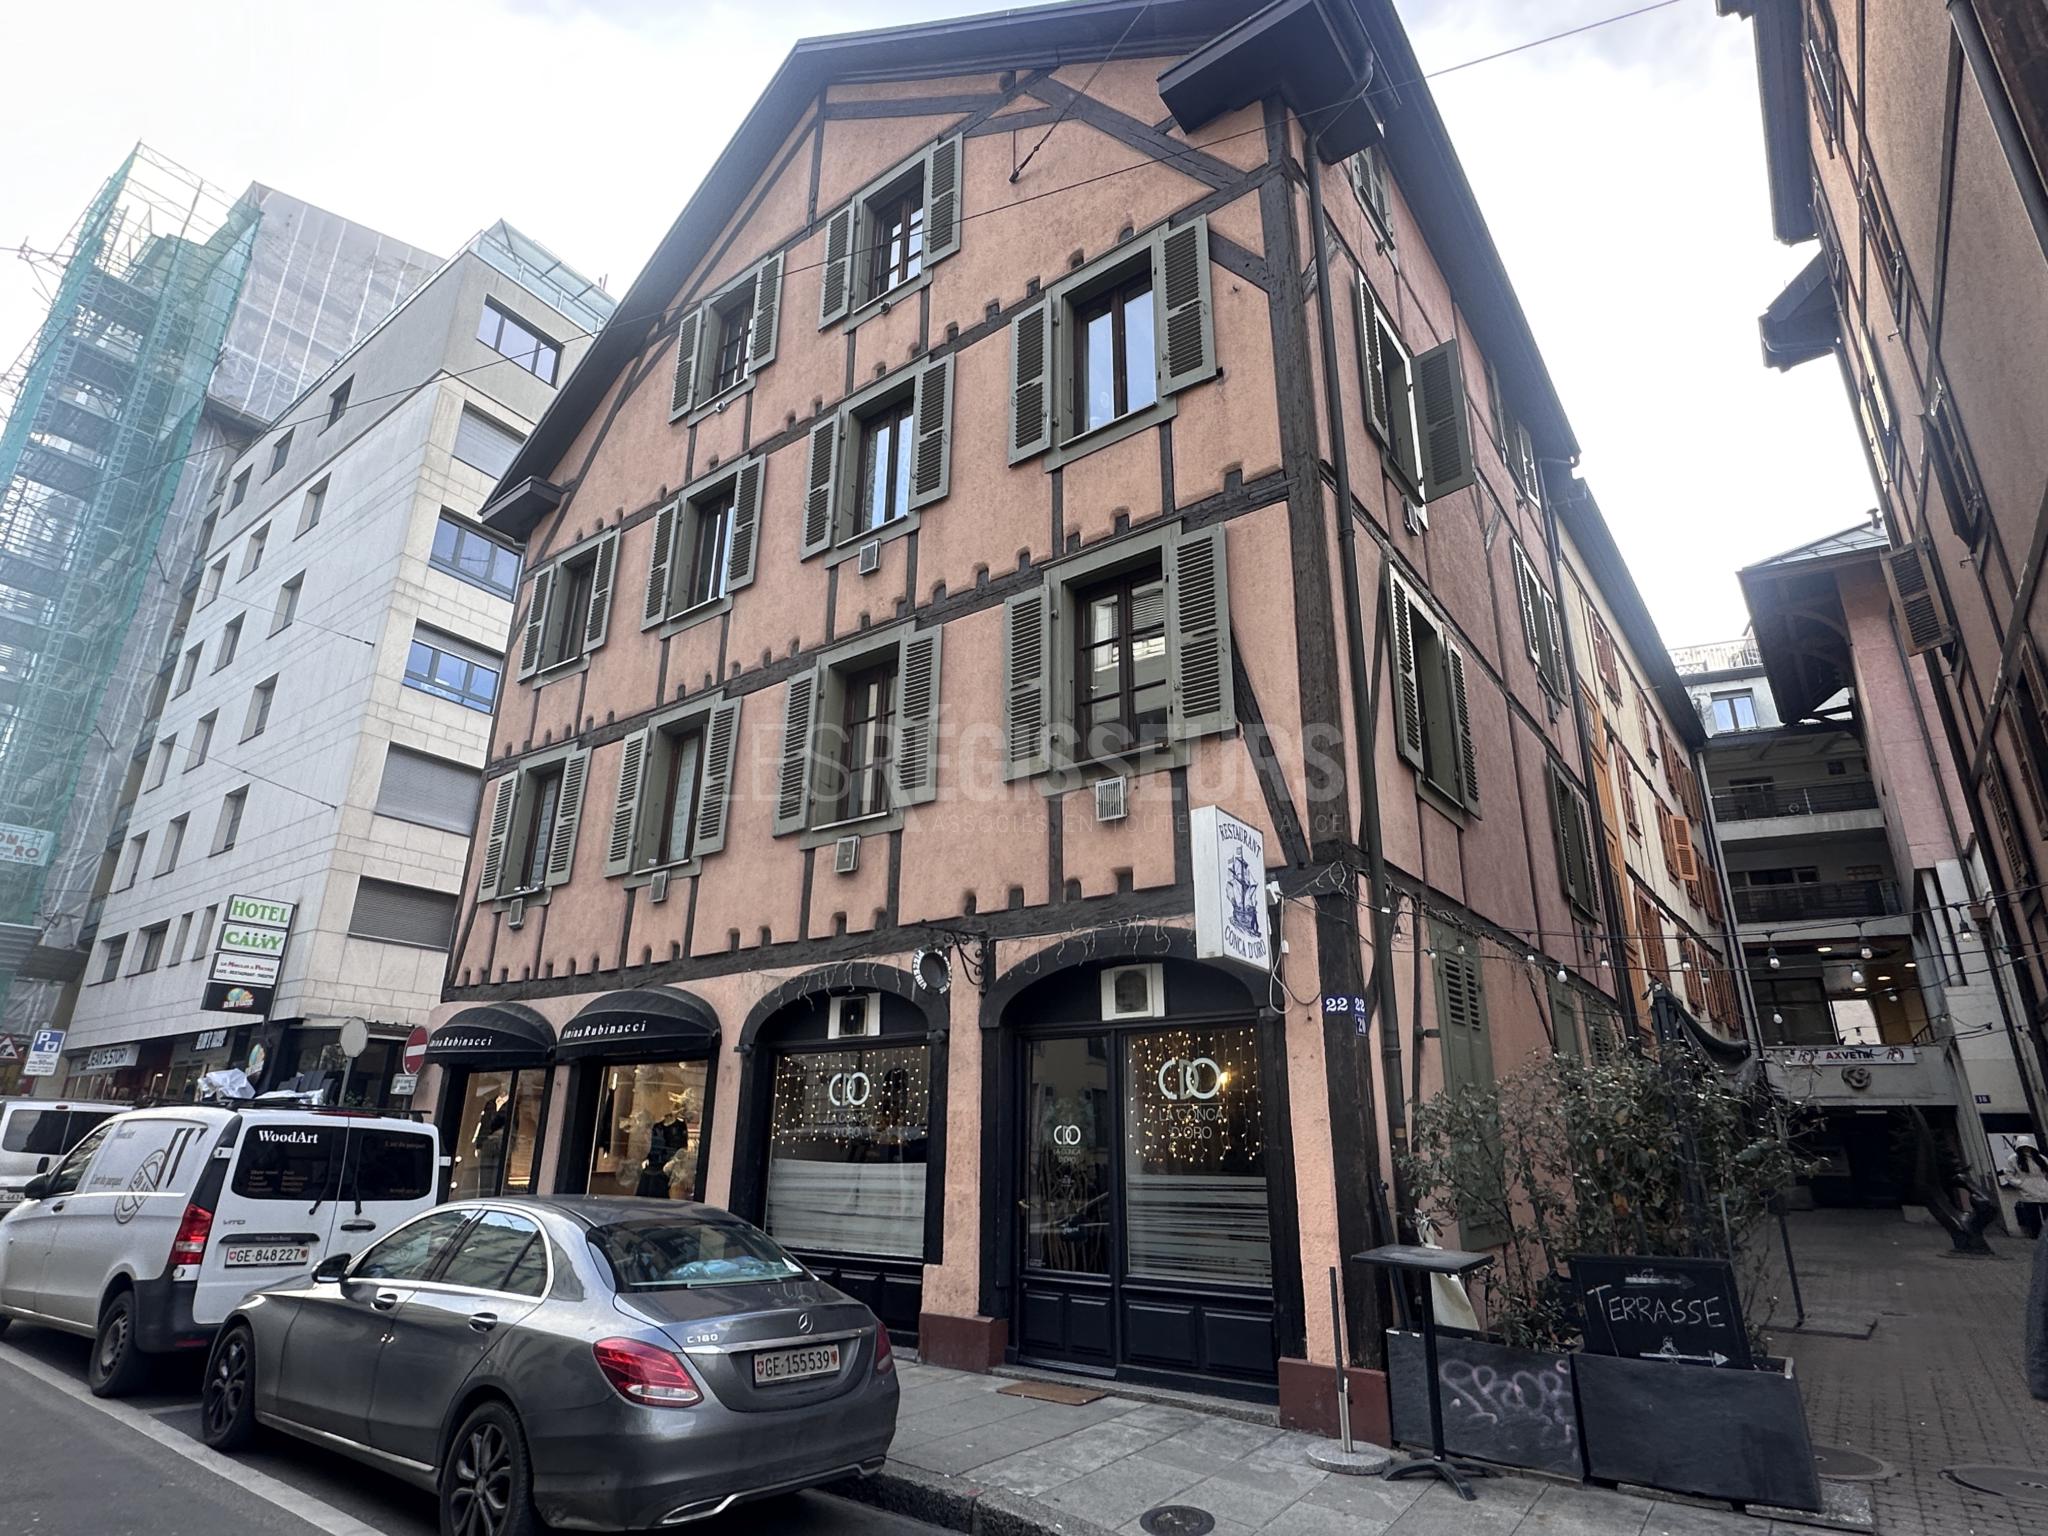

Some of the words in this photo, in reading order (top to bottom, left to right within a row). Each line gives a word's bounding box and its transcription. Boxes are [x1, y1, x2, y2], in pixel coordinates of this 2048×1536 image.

[1219, 823, 1261, 858] RESTAURANT
[232, 901, 288, 923] HOTEL
[224, 931, 283, 950] CALVY
[1225, 925, 1247, 957] CONCA
[1247, 939, 1266, 959] D'ORO
[1326, 997, 1348, 1012] 22
[1355, 997, 1365, 1013] 22
[584, 1020, 647, 1037] Rubinacci
[38, 1032, 51, 1044] P
[1160, 1109, 1174, 1121] LA
[1178, 1108, 1224, 1121] CONCA
[258, 1130, 318, 1144] WoodArt
[1171, 1126, 1213, 1139] D'ORO
[1586, 1284, 1727, 1357] TERRASSE
[696, 1333, 719, 1343] 180
